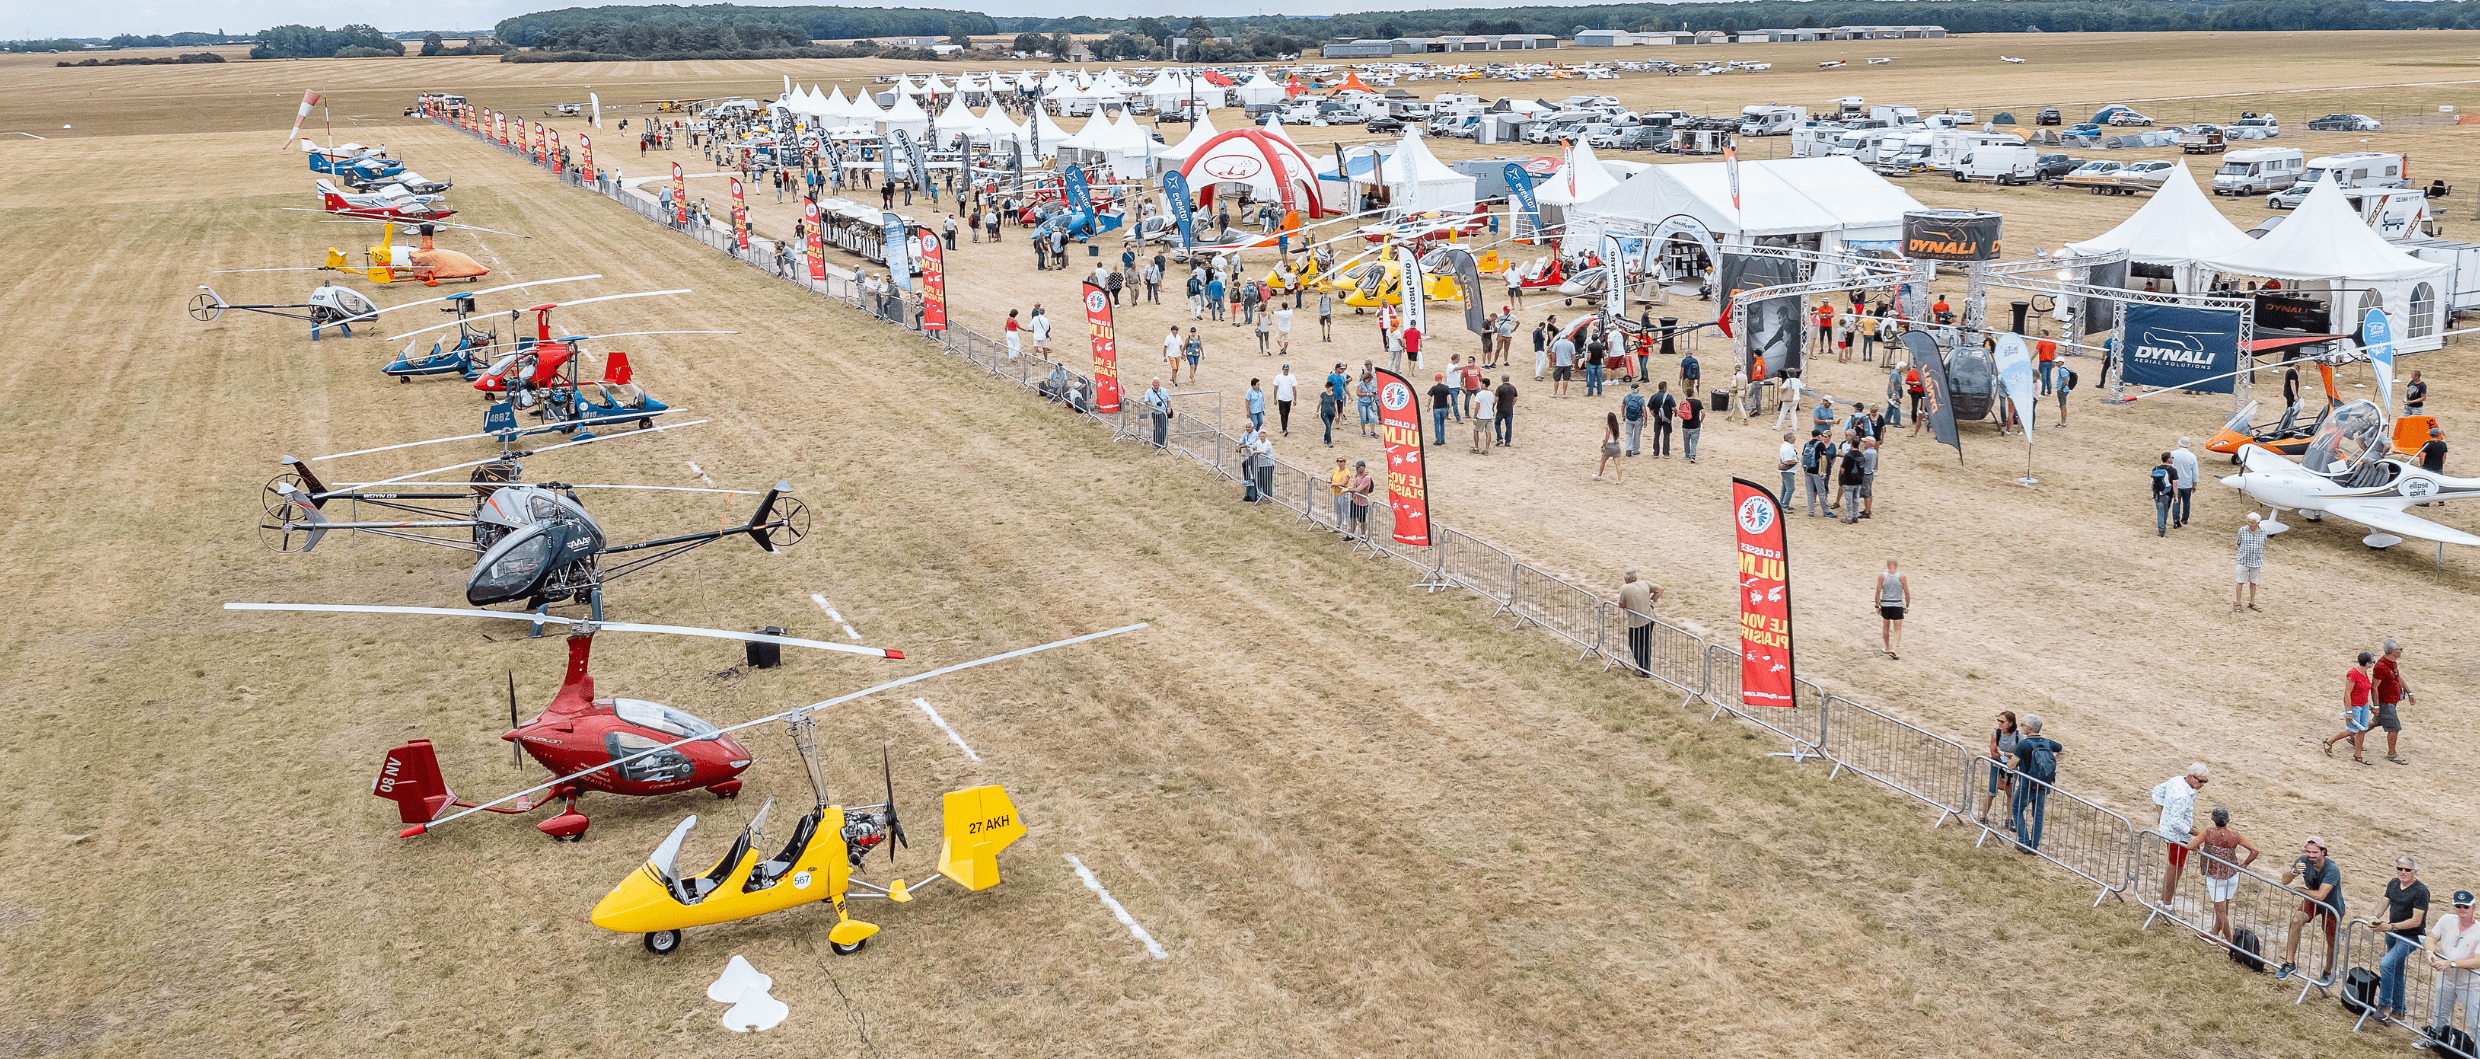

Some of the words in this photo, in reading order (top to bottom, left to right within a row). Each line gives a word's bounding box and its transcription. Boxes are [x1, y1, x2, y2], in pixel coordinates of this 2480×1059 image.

[1074, 184, 1091, 209] evektor
[1515, 183, 1536, 209] evektor
[1172, 192, 1189, 222] evektor
[1909, 239, 1976, 254] DYNALI
[2265, 303, 2308, 313] DYNALI
[2135, 346, 2215, 364] DYNALI
[2135, 357, 2161, 365] AERIAL
[2165, 361, 2211, 370] SOLUTIONS
[2409, 481, 2429, 489] ellipse
[2410, 488, 2426, 498] spirit
[505, 514, 522, 524] H3
[385, 756, 402, 777] NV
[379, 777, 396, 793] 08
[969, 822, 983, 834] 27
[985, 815, 1010, 831] AKH
[794, 874, 810, 885] 567
